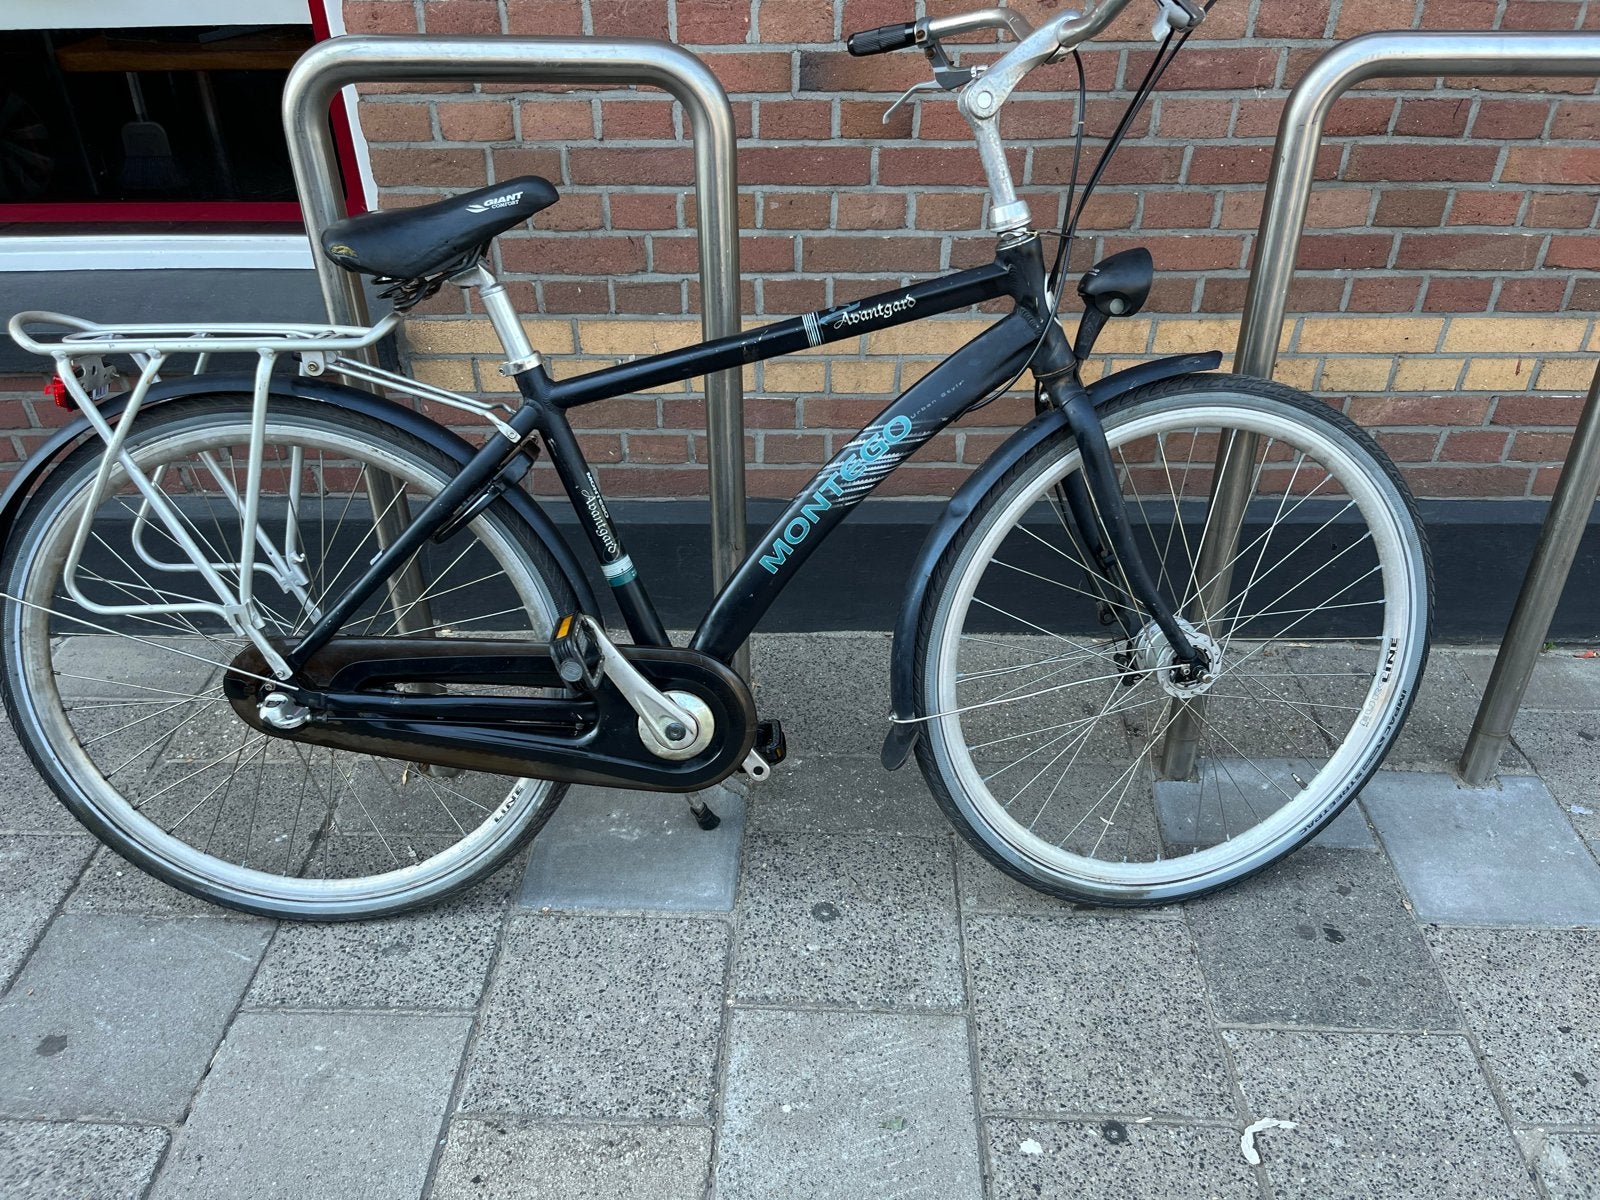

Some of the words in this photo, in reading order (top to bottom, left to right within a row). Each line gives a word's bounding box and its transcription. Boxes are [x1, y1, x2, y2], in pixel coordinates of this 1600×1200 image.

[483, 191, 524, 207] GIANT
[833, 293, 916, 330] Avantgard
[586, 471, 610, 519] MONTEGO
[758, 414, 912, 575] MONTEGO
[581, 489, 618, 554] Avantgard
[1381, 637, 1398, 683] LINE
[494, 784, 525, 824] LINE
